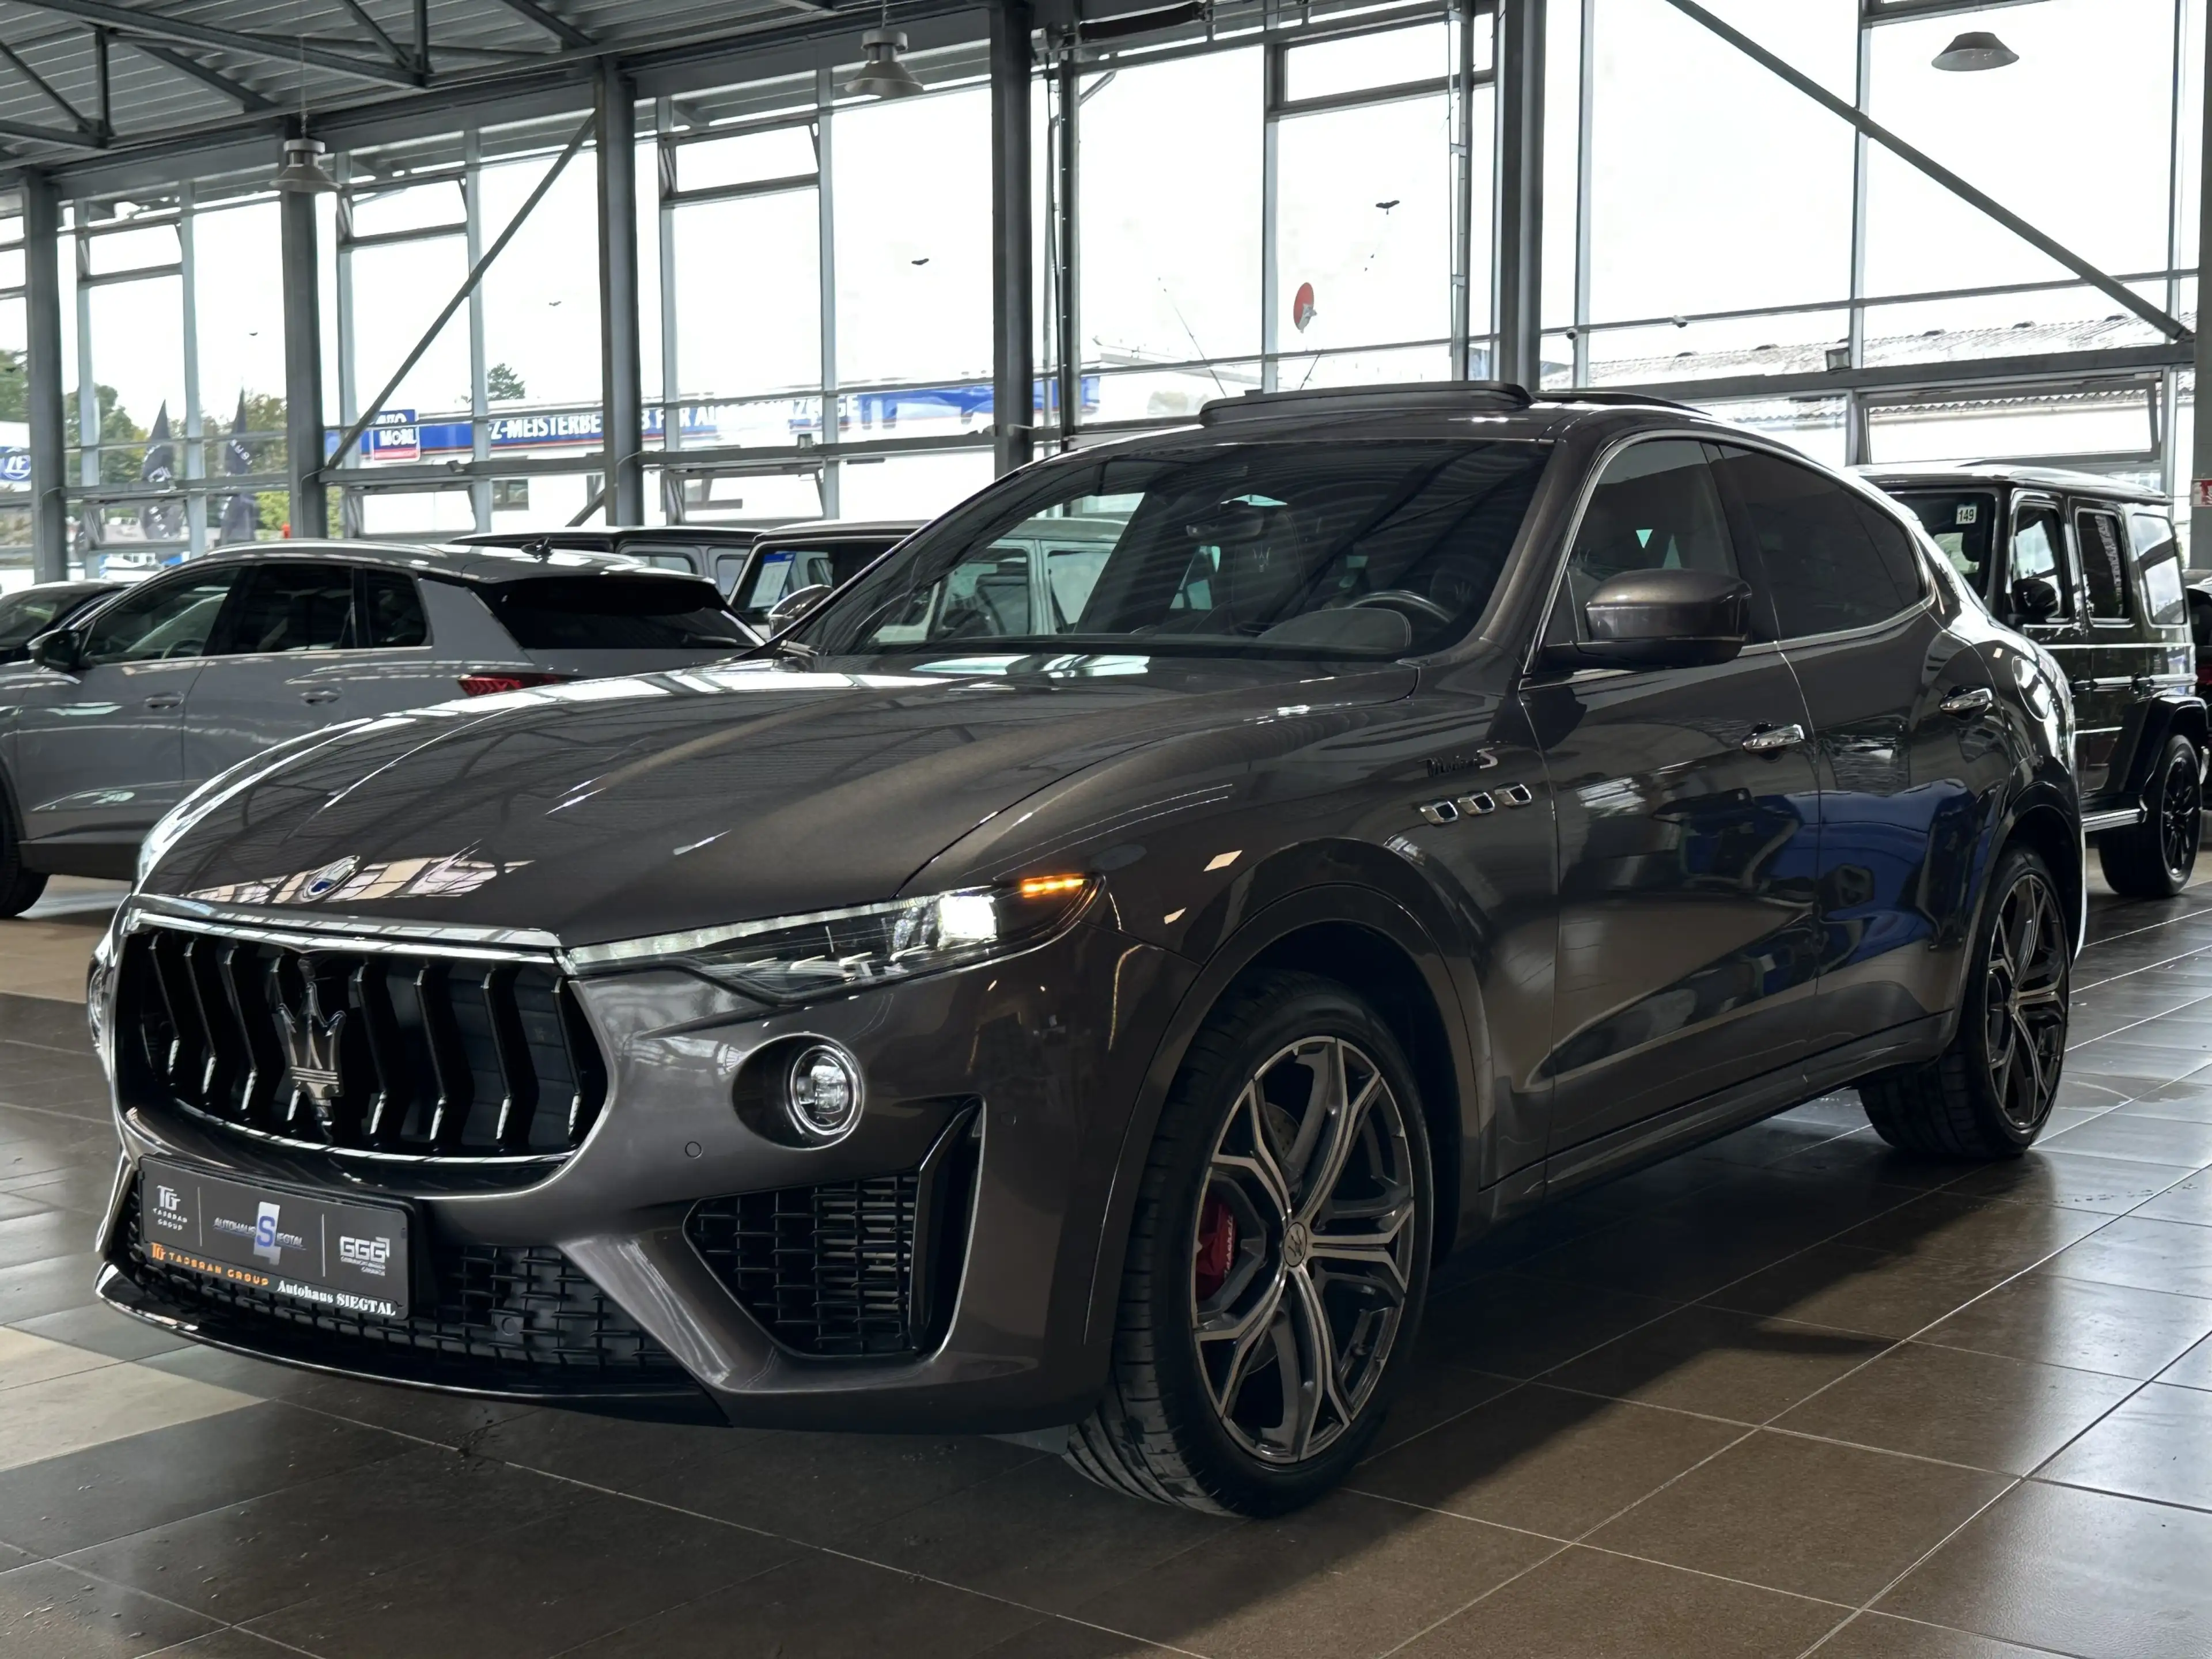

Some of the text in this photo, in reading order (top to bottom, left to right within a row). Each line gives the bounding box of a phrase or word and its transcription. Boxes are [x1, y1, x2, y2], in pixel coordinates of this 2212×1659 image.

[1959, 509, 1974, 521] 149
[340, 1236, 387, 1263] GGG
[228, 1268, 269, 1286] GROUP
[276, 1280, 396, 1316] Autohaus SIEGTAL
